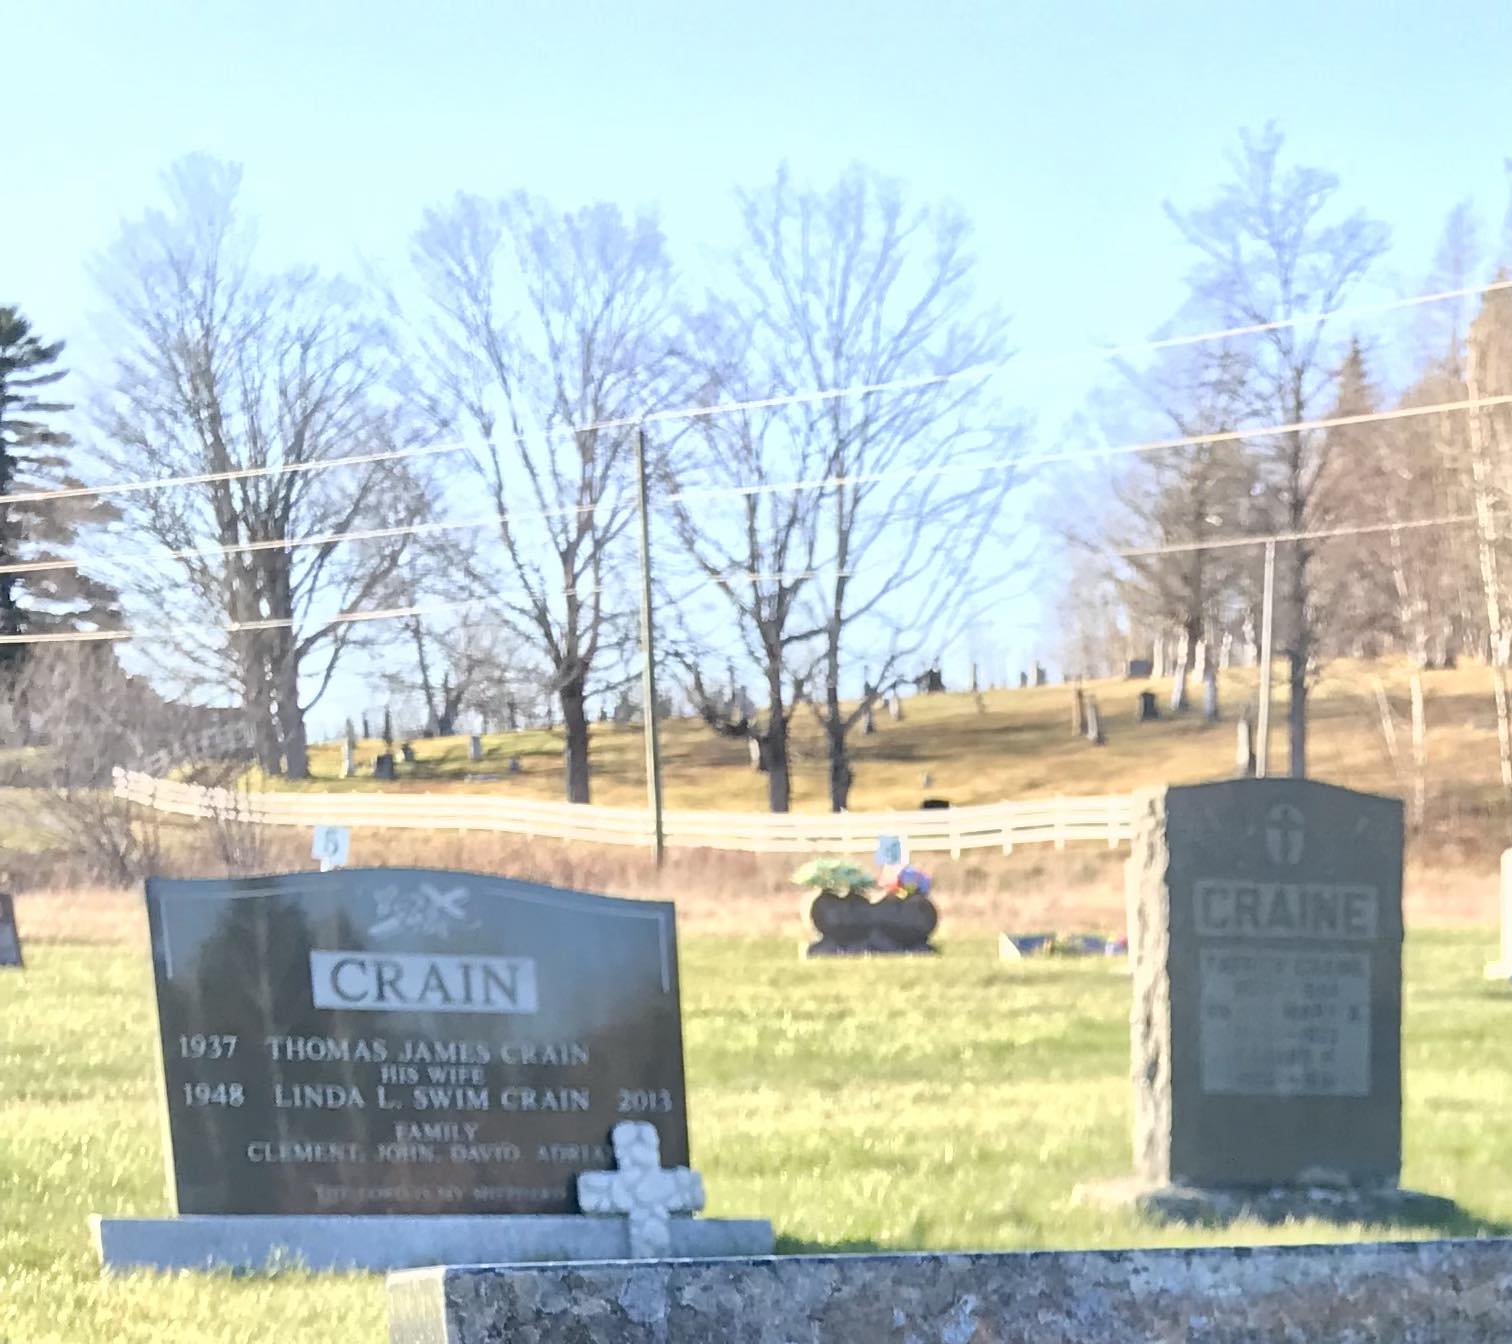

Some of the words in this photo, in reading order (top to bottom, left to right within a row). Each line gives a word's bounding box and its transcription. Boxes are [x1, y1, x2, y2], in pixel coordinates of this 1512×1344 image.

[1202, 886, 1369, 931] CRAINE
[330, 957, 521, 1006] CRAIN
[179, 1034, 239, 1060] 1937
[267, 1035, 388, 1063] THOMAS
[400, 1039, 491, 1065] JAMES
[500, 1043, 590, 1066] CRAIN
[380, 1063, 420, 1085] HIS
[427, 1065, 486, 1086] WIFE
[184, 1081, 245, 1108] 1948
[274, 1083, 367, 1110] LINDA
[412, 1086, 490, 1112] SWIM
[500, 1086, 590, 1112] CRAIN
[394, 1120, 480, 1143] FAMILY
